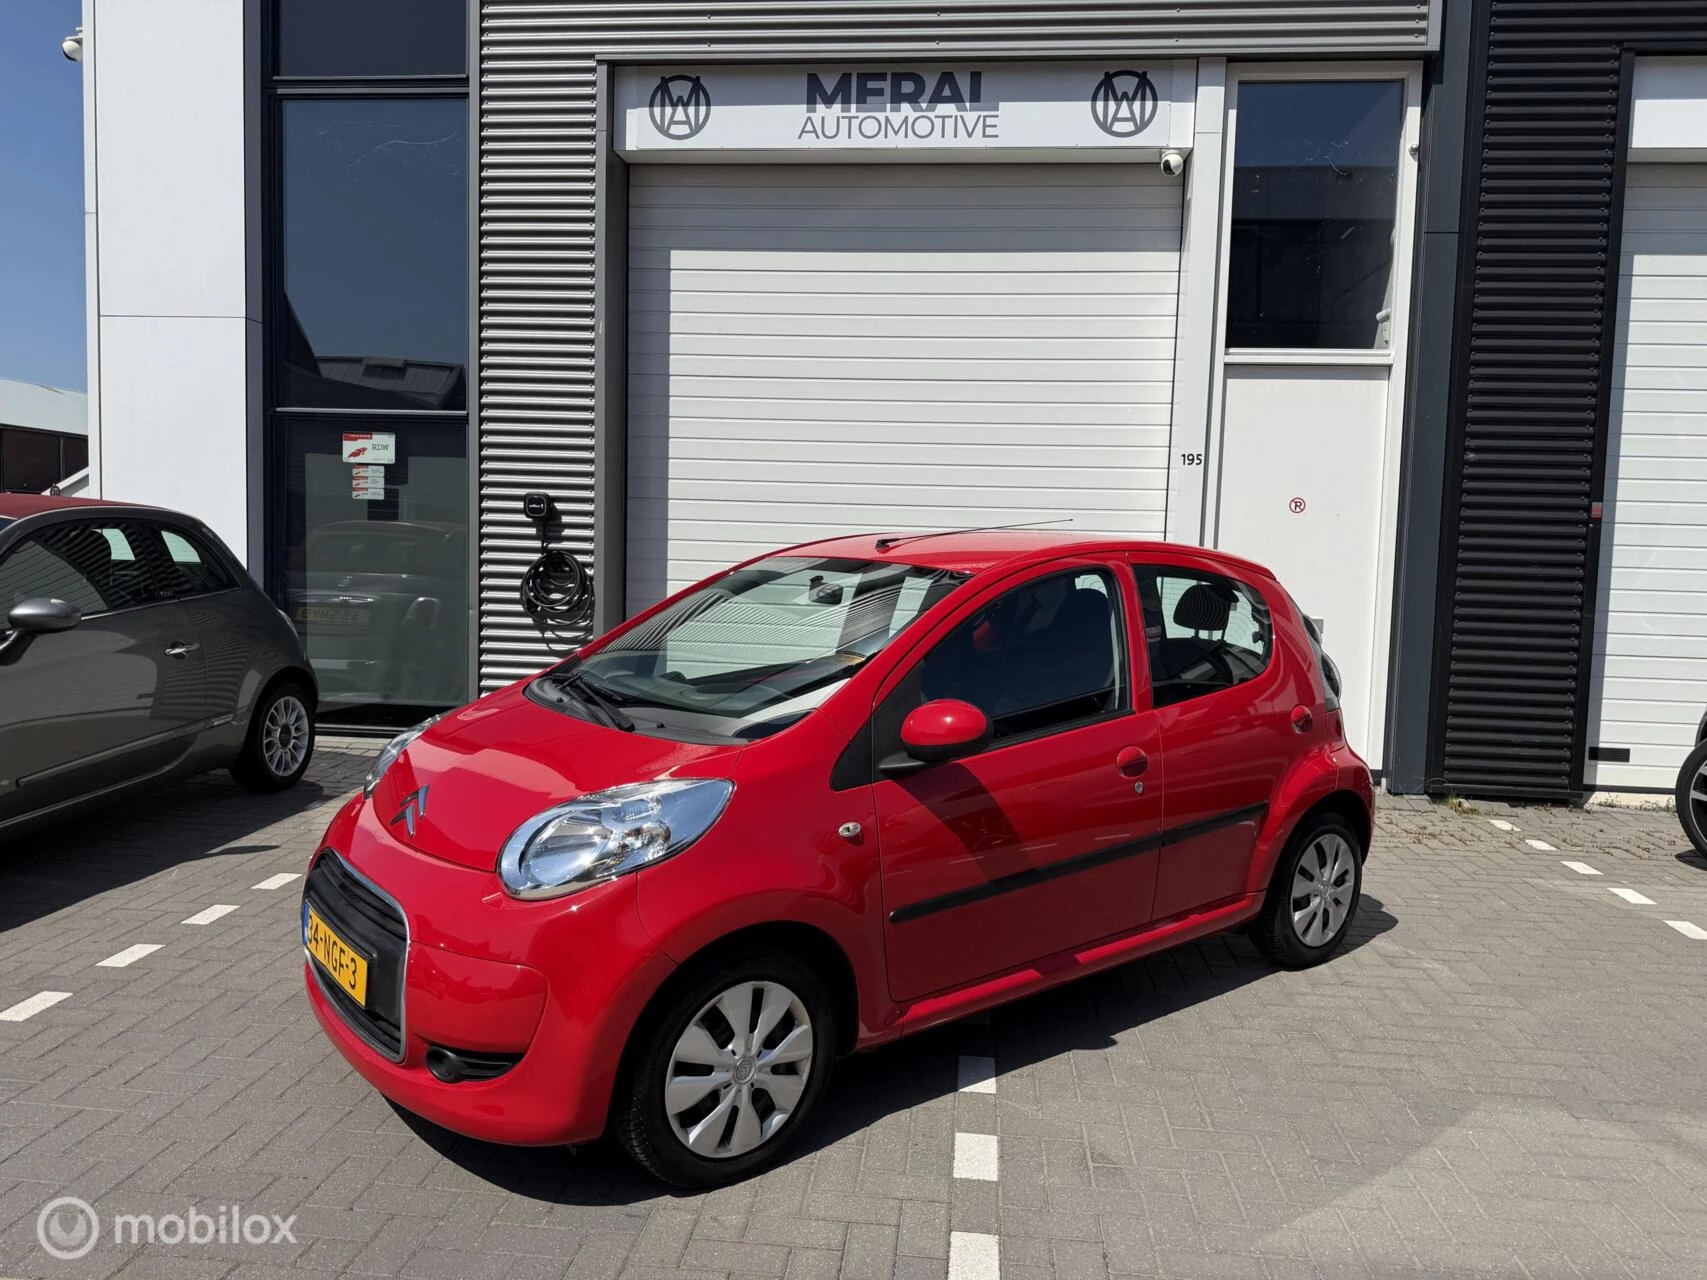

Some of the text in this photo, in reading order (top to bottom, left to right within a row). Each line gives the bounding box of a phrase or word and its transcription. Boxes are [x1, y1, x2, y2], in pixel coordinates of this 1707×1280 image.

[806, 71, 999, 113] MERAL
[798, 114, 999, 139] AUTOMOTIVE
[1181, 453, 1203, 466] 195
[307, 914, 357, 990] 34-NGF-3
